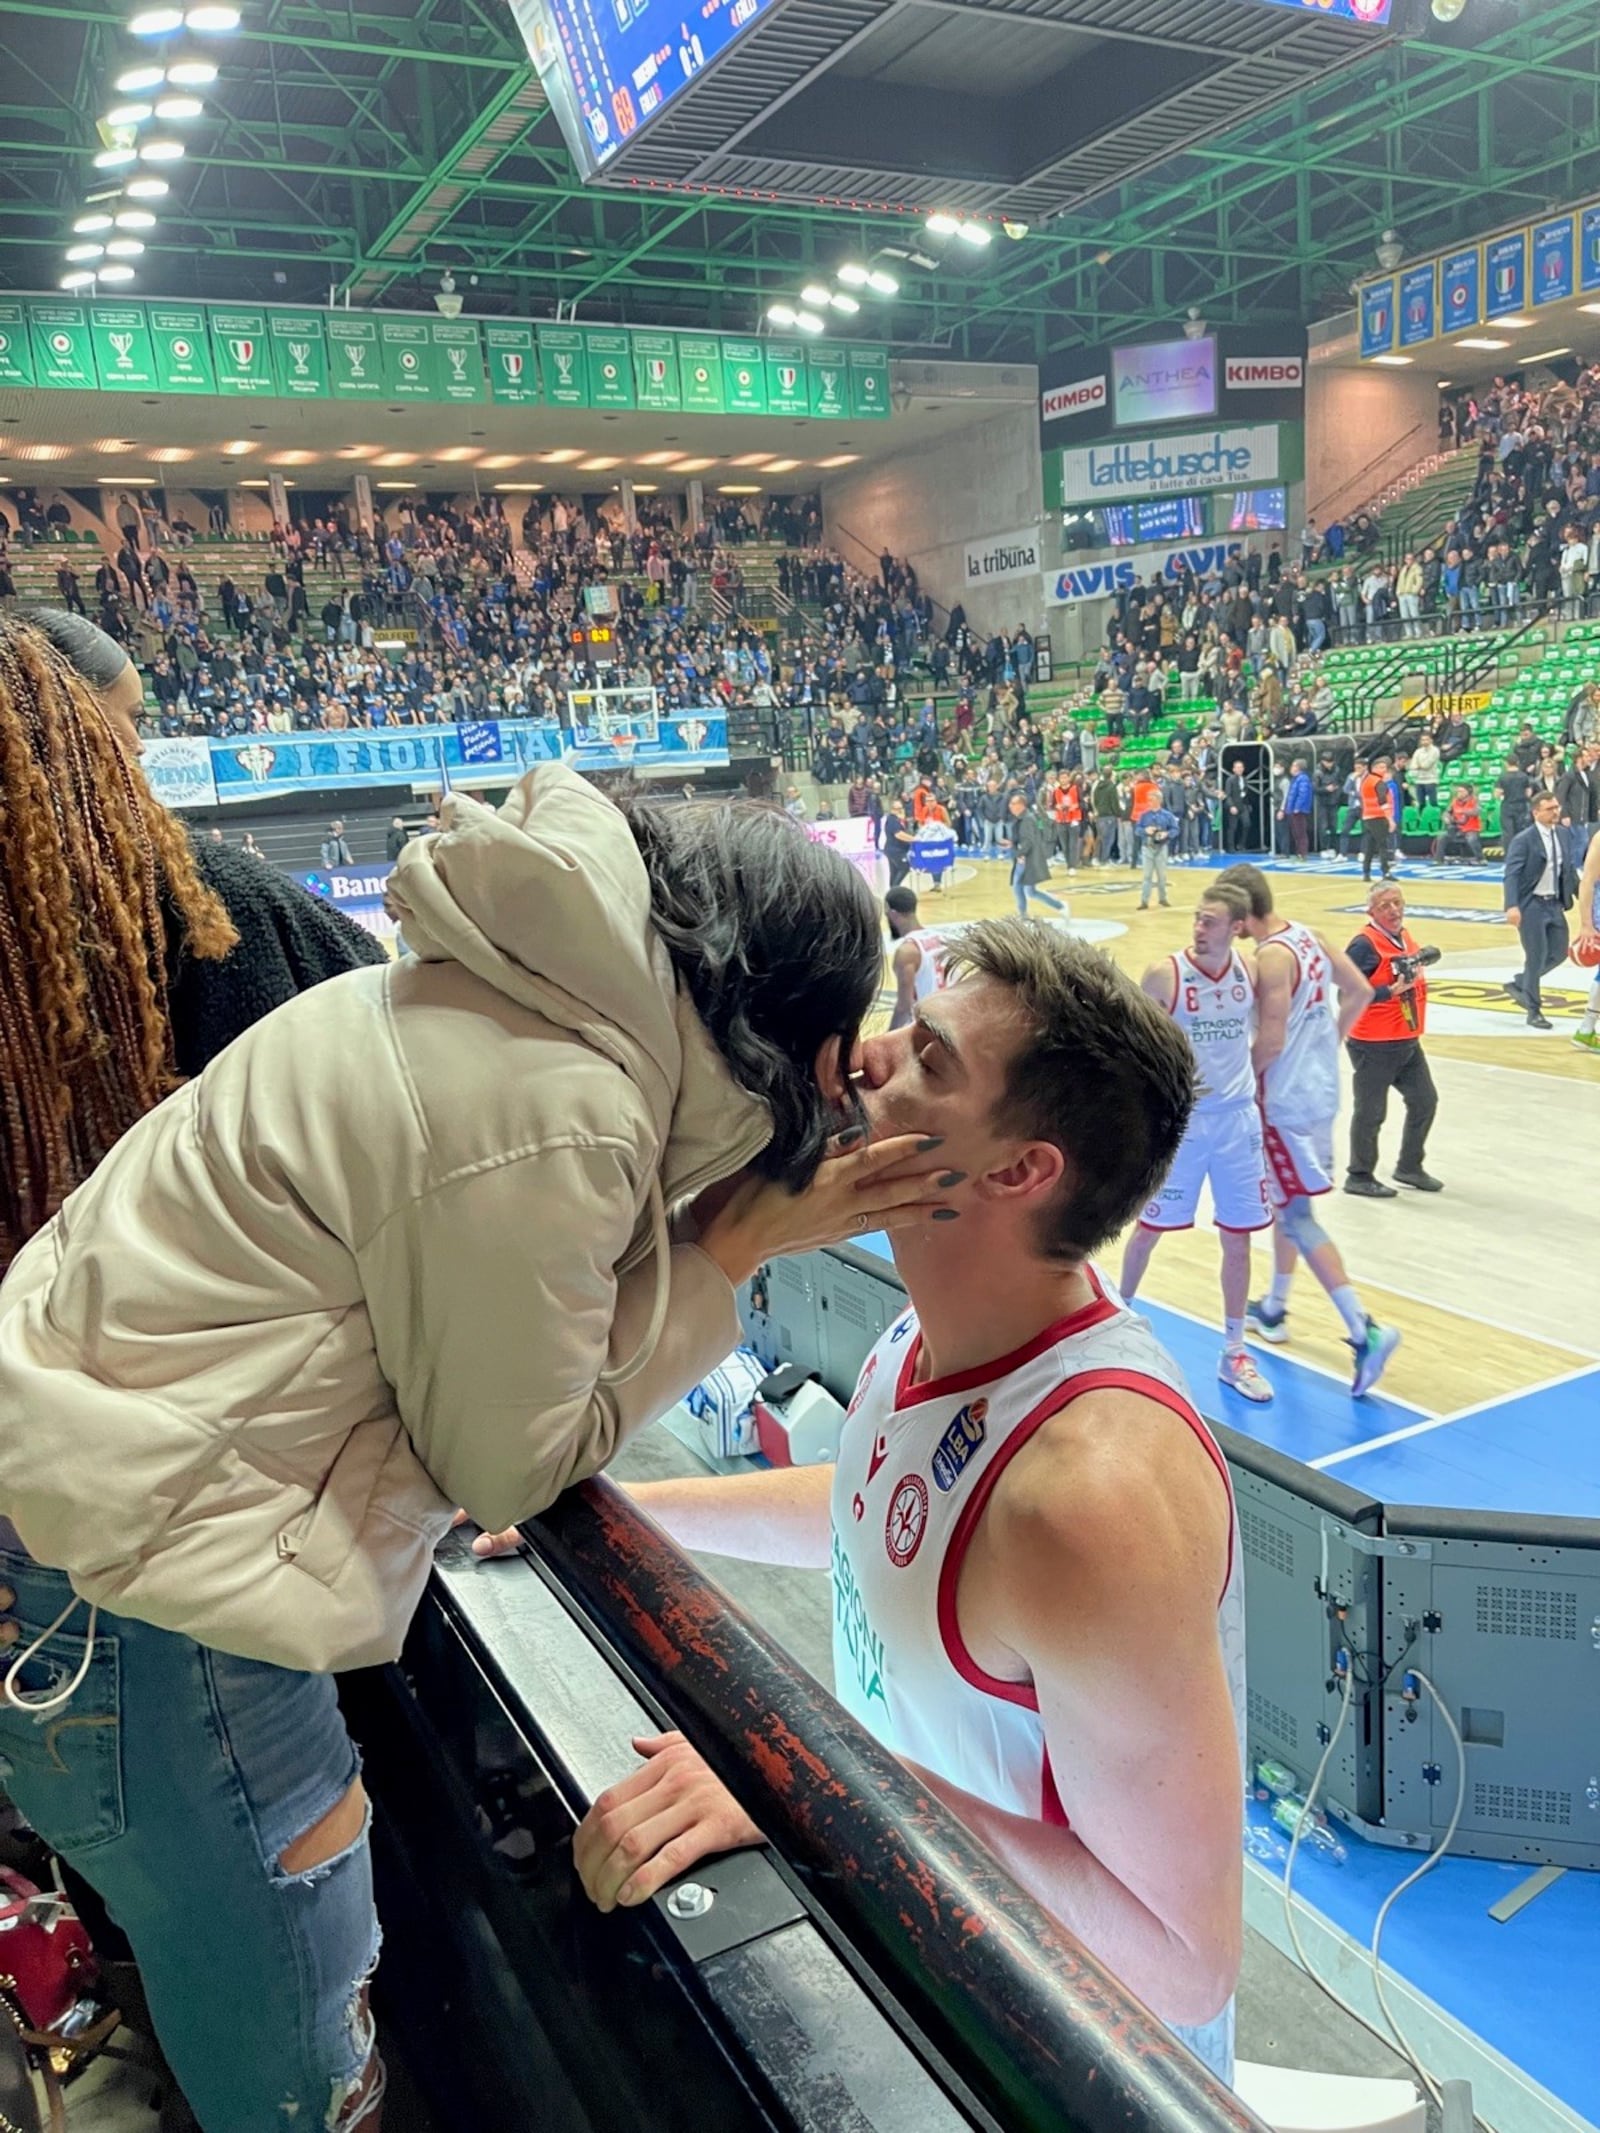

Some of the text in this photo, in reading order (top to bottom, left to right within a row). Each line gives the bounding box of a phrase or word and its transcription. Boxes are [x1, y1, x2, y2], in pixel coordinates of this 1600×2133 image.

[1119, 365, 1211, 390] ANTHEA
[1228, 365, 1300, 381] KIMBO
[1044, 385, 1104, 413] KIMBO
[1089, 434, 1251, 486] lattebusche
[968, 548, 1036, 577] la tribuna
[1055, 561, 1136, 600] AVIS
[1436, 697, 1480, 713] OLFERT
[334, 736, 440, 774] FIOI
[948, 1426, 970, 1463] LBA
